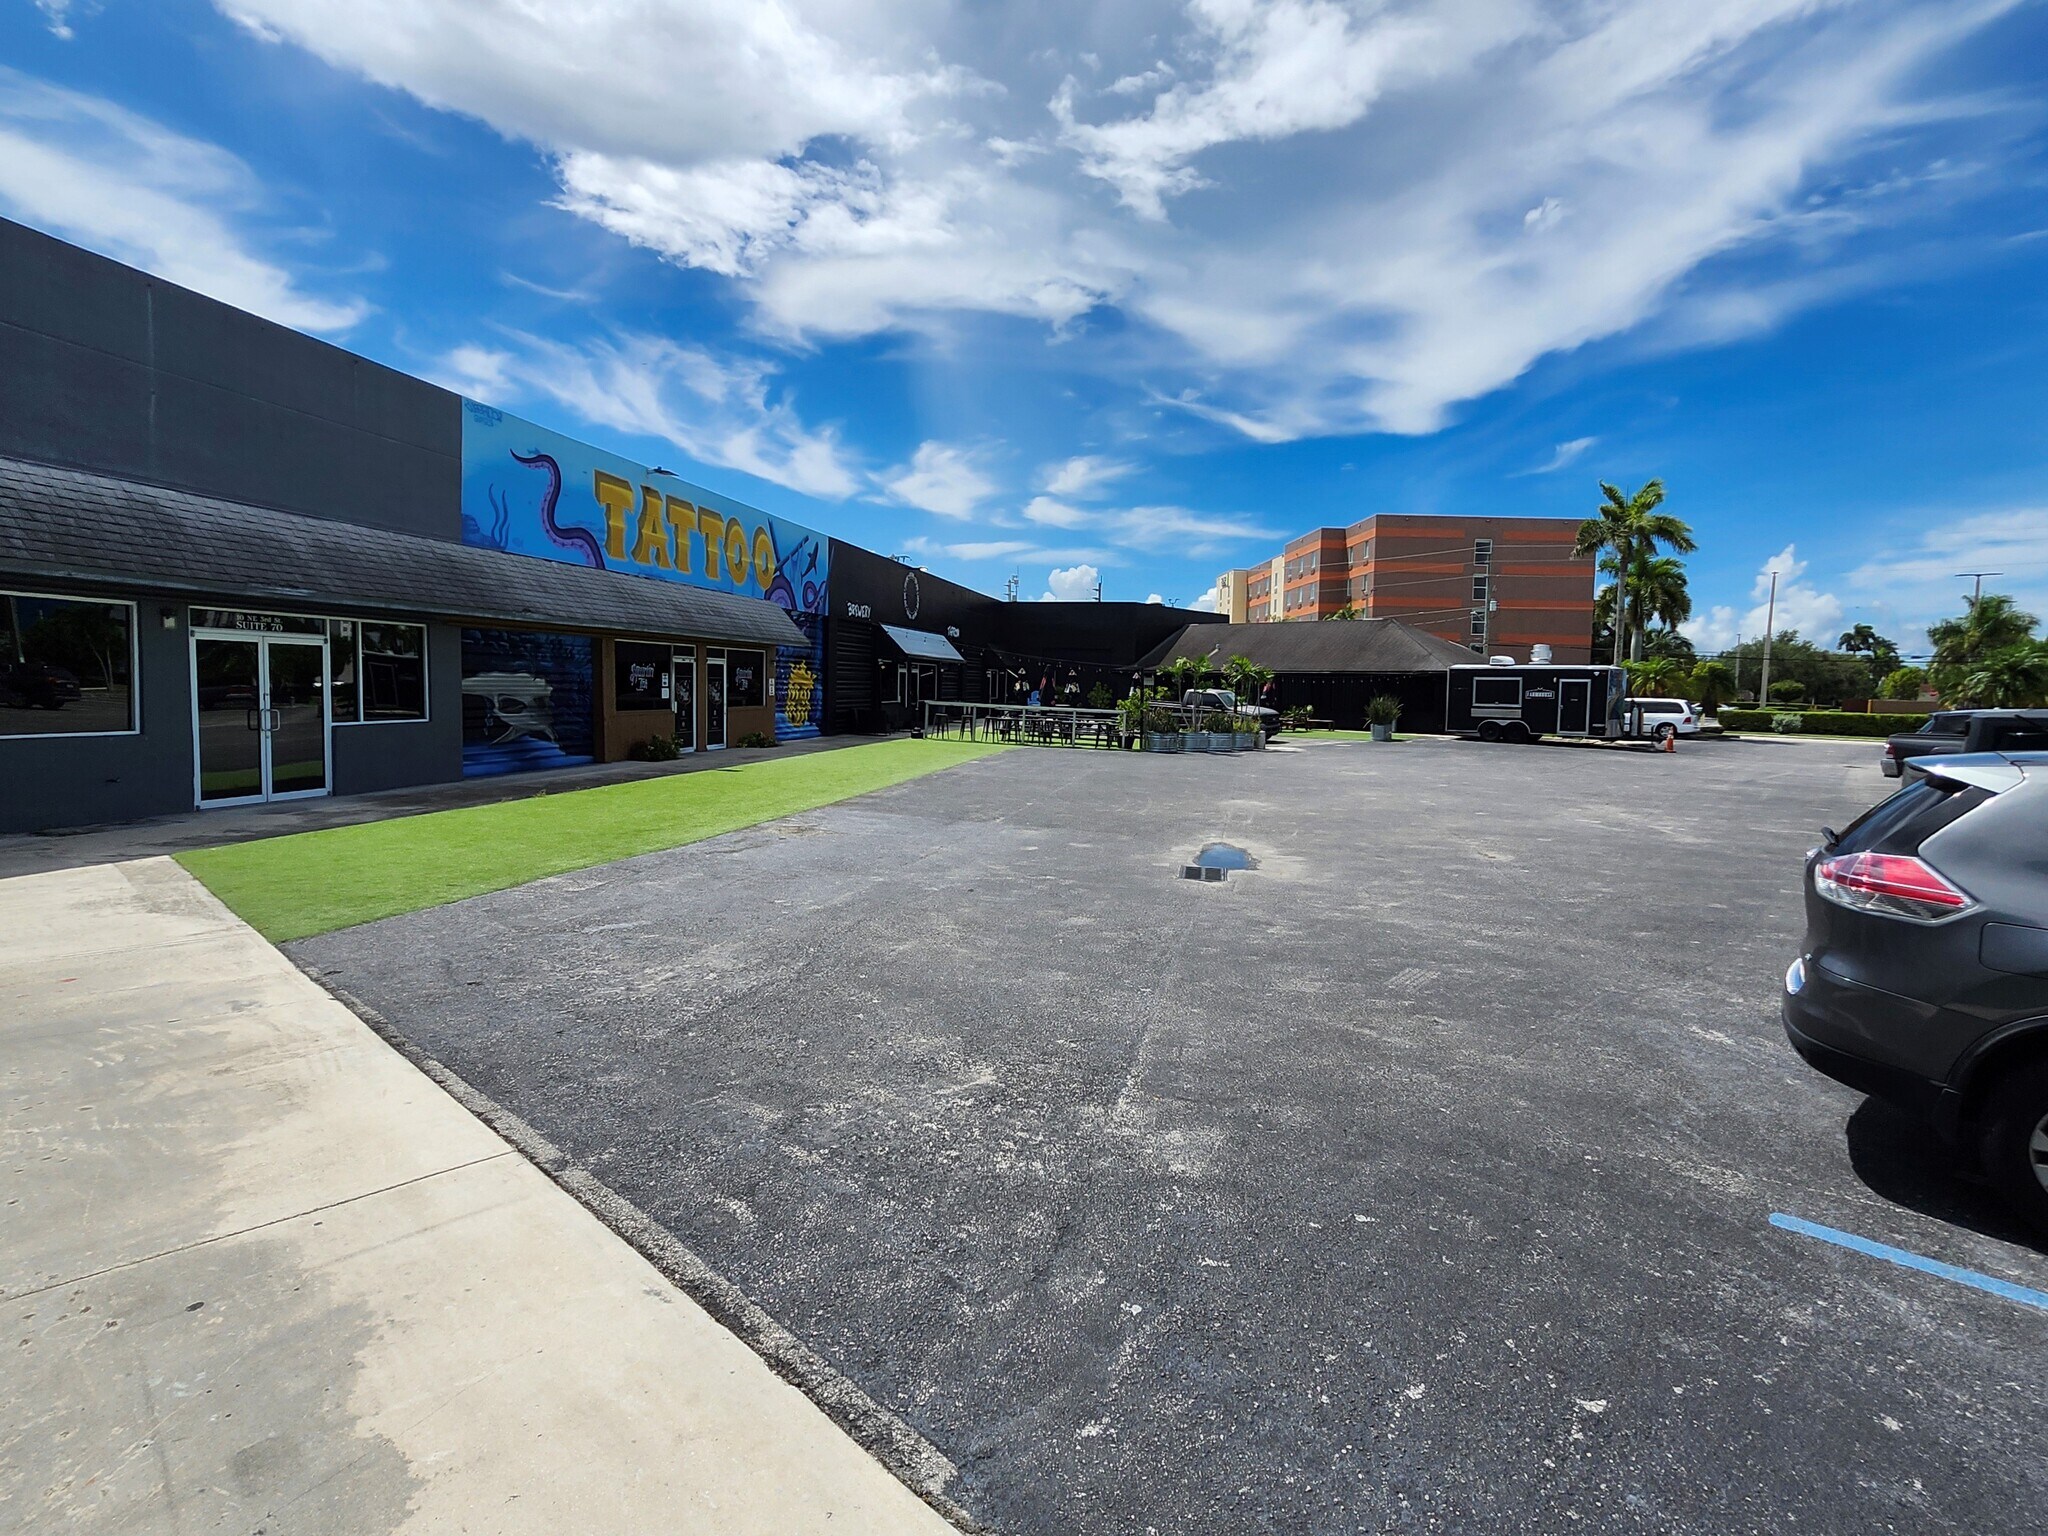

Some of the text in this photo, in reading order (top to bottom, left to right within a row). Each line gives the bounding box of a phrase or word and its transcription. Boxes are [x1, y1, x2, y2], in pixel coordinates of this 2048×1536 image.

[594, 470, 776, 591] TATTOO
[847, 602, 871, 618] BREWERY
[236, 621, 283, 632] SUITE 70
